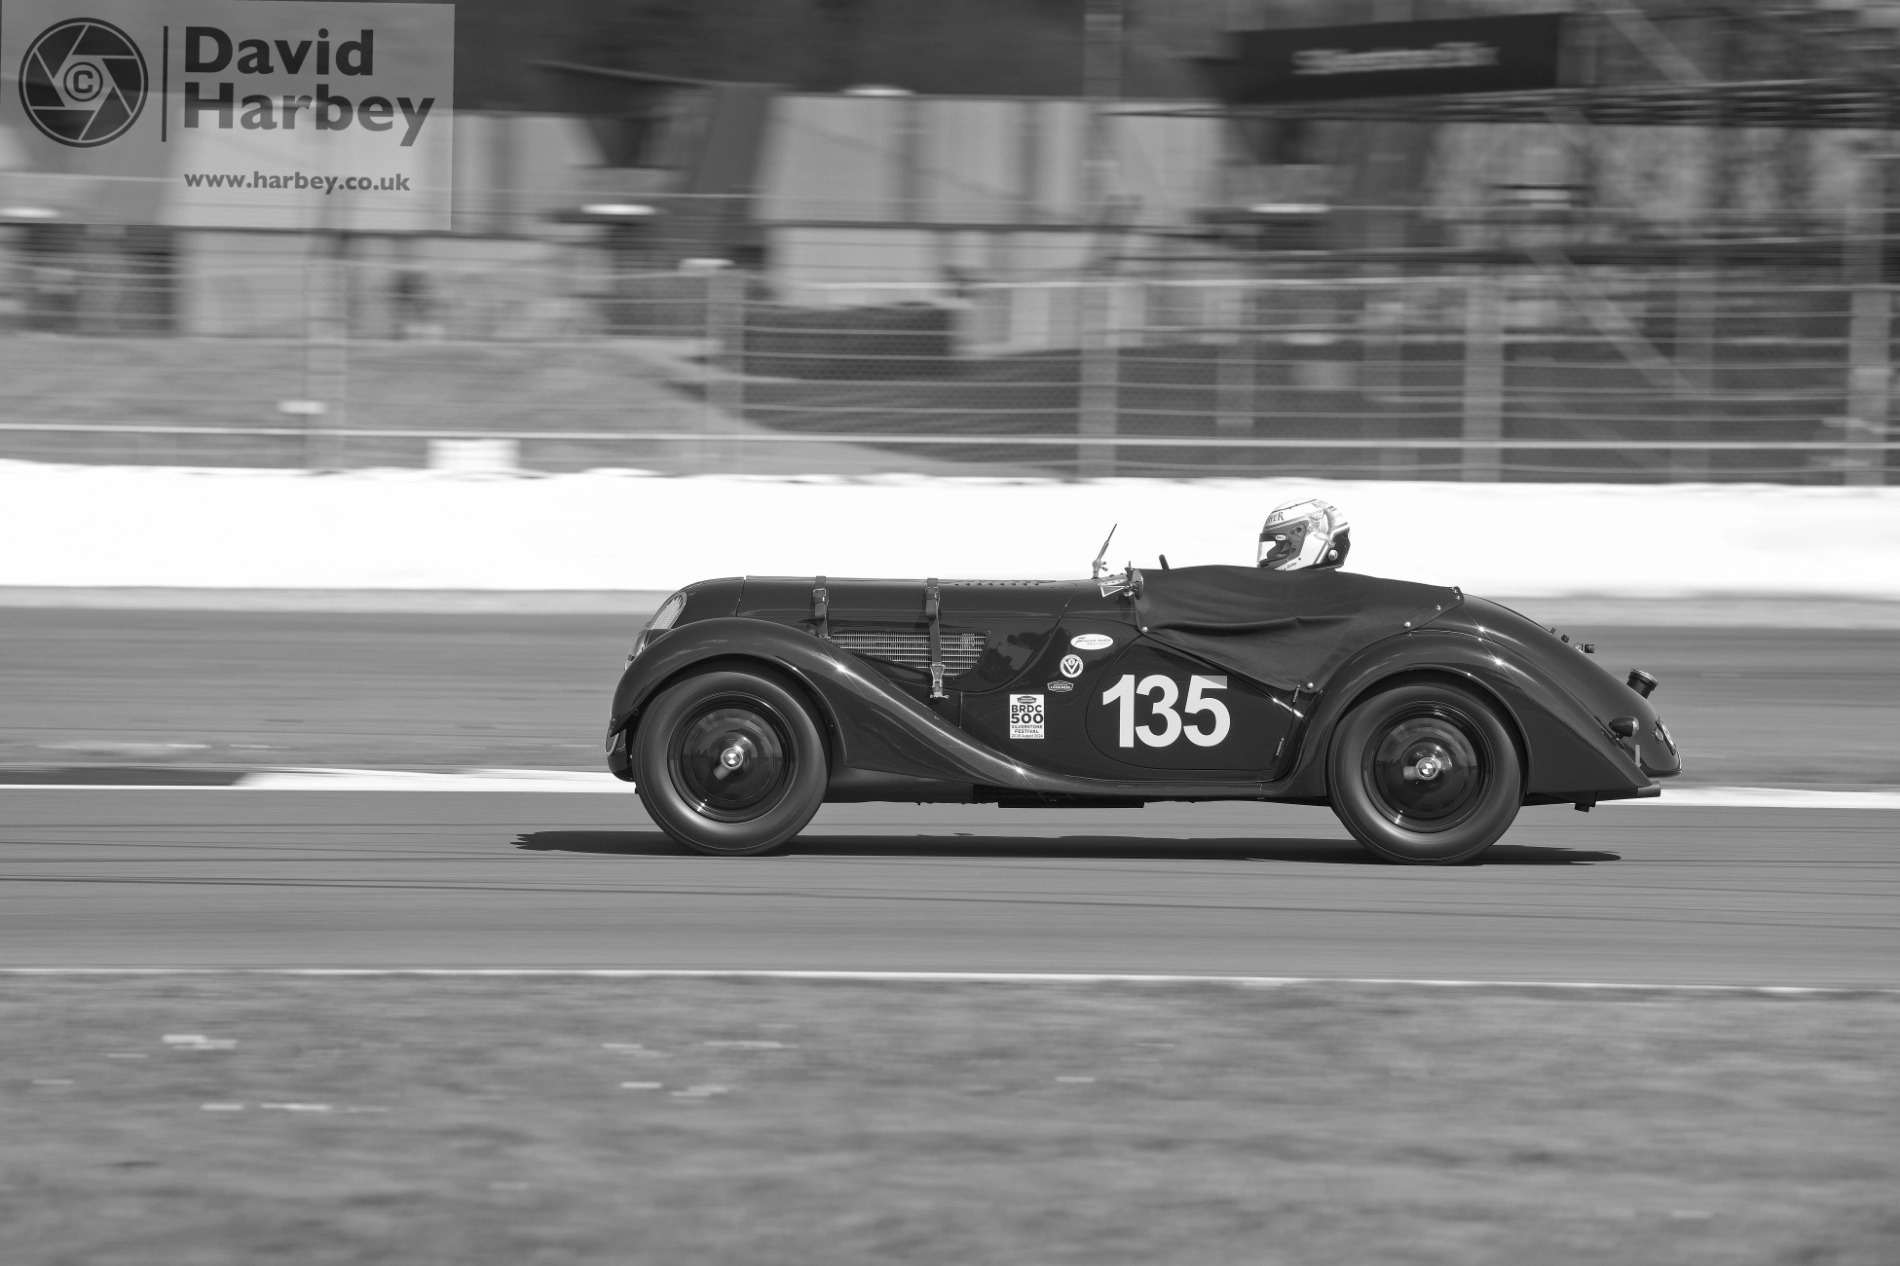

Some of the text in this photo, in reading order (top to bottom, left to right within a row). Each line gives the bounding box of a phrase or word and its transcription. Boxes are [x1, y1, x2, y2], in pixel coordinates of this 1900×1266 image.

[1012, 704, 1042, 713] BRDC
[1102, 674, 1231, 748] 135
[1011, 713, 1044, 724] 500
